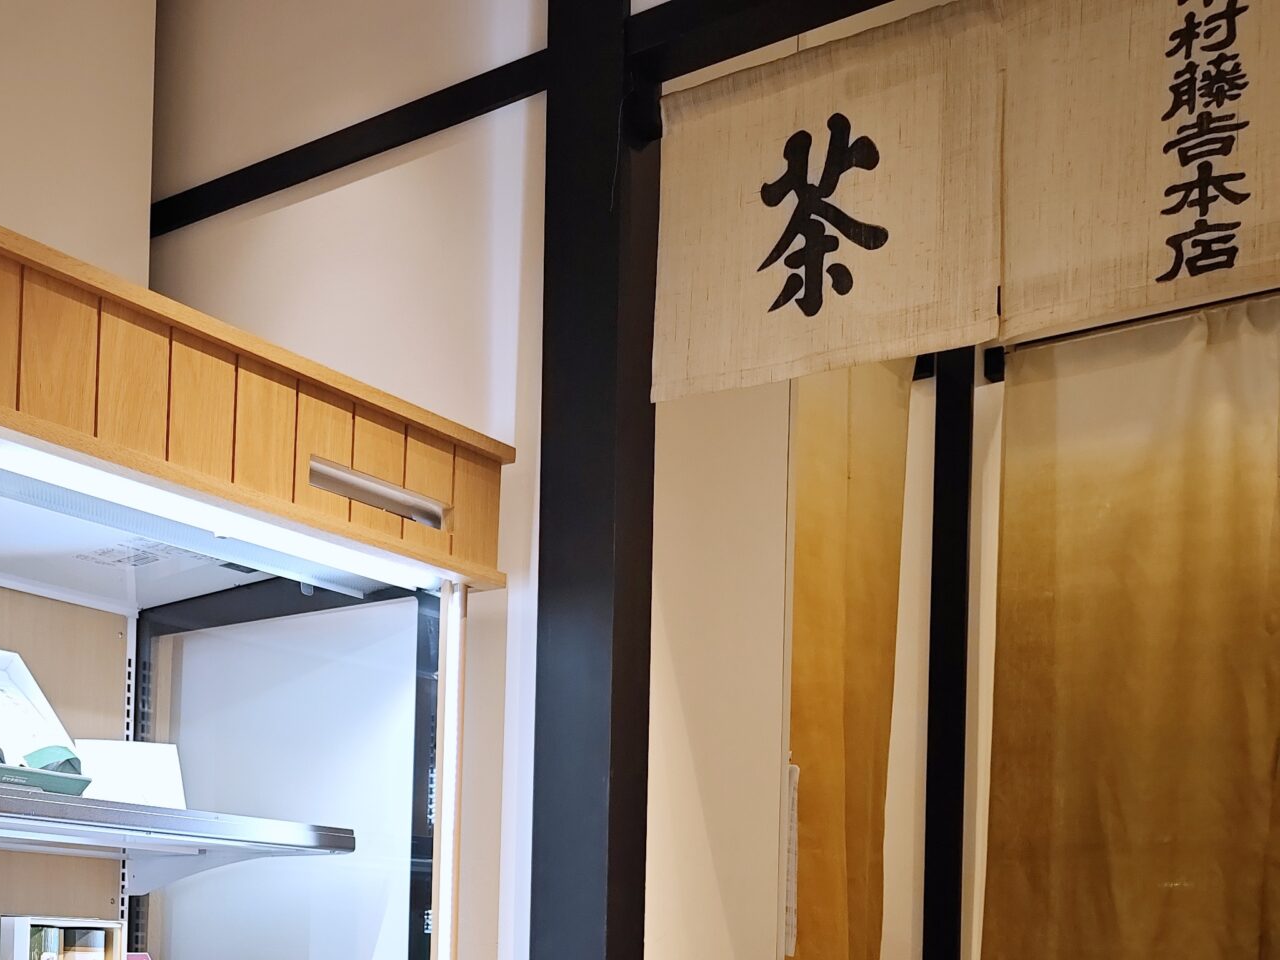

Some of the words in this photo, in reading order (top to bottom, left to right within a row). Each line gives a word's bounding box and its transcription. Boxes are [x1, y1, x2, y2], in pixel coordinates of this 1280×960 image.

[757, 112, 889, 317] 茶
[1155, 0, 1250, 283] 村藤吉本店
